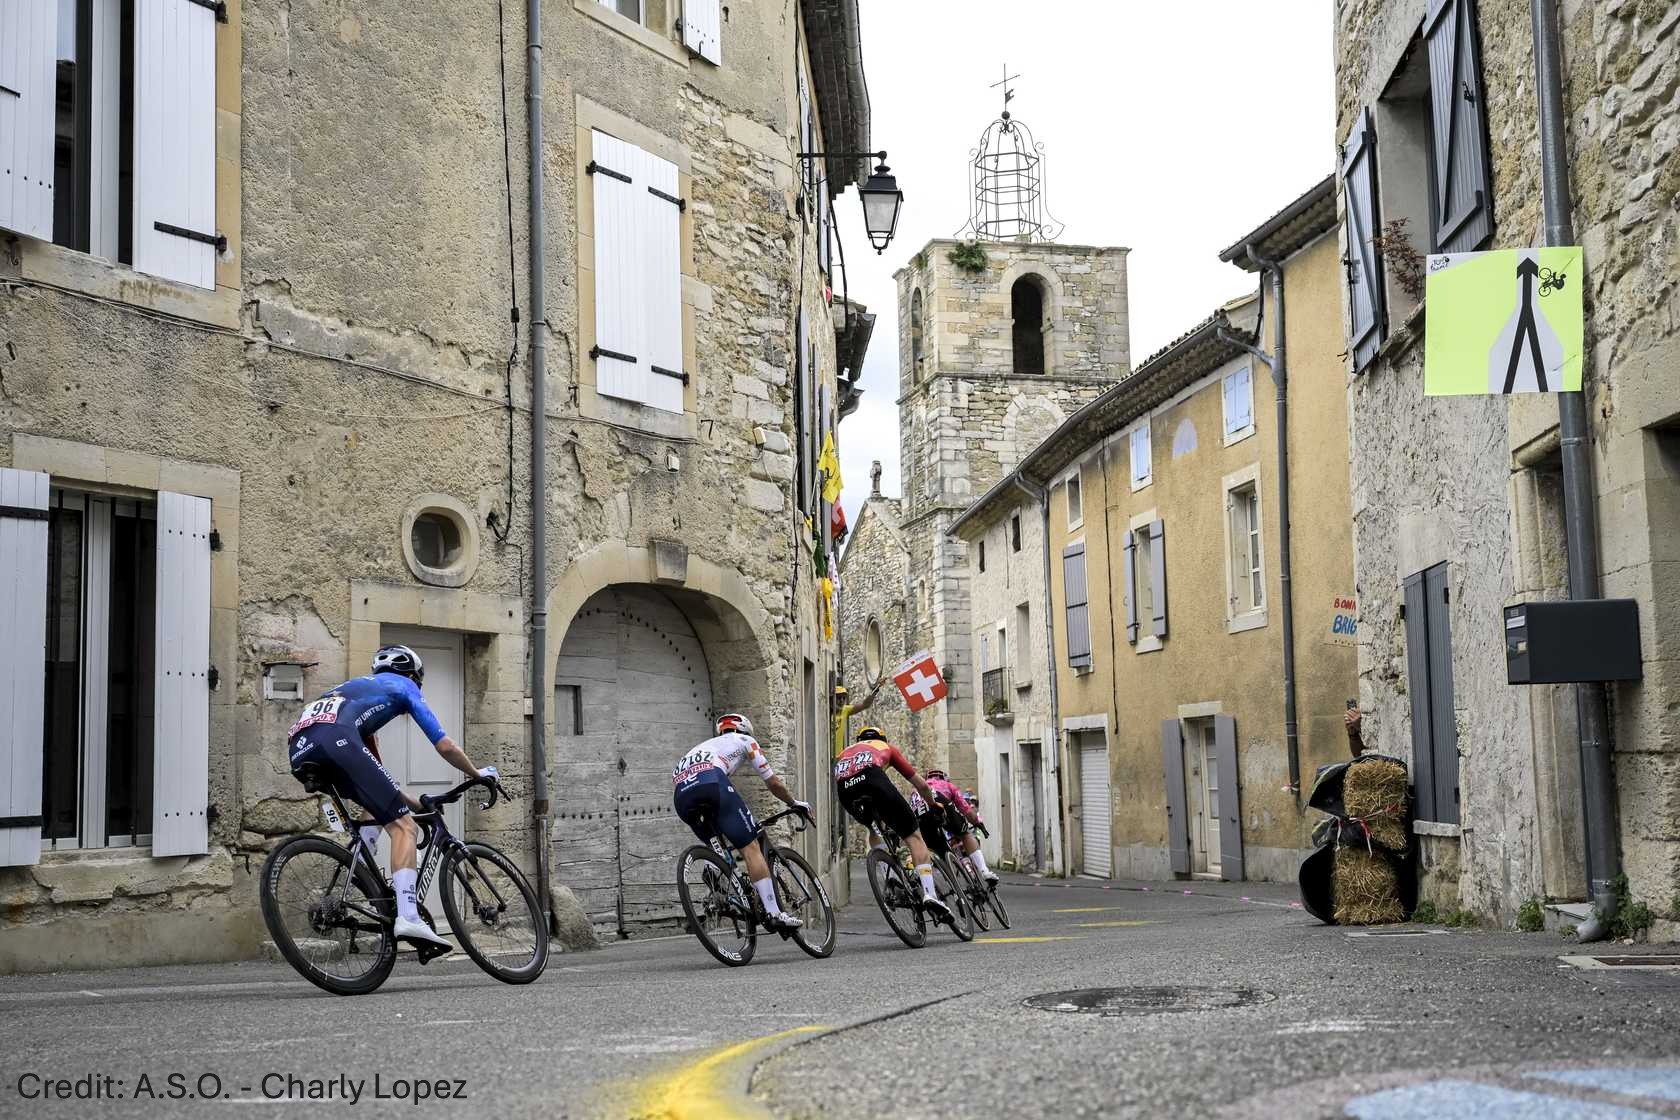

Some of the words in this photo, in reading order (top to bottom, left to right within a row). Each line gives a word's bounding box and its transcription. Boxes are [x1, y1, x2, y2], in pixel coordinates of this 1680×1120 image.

[311, 700, 334, 717] 96
[361, 703, 386, 721] UNITED
[689, 750, 711, 764] 182
[326, 809, 339, 823] 96
[269, 855, 288, 899] MICHE
